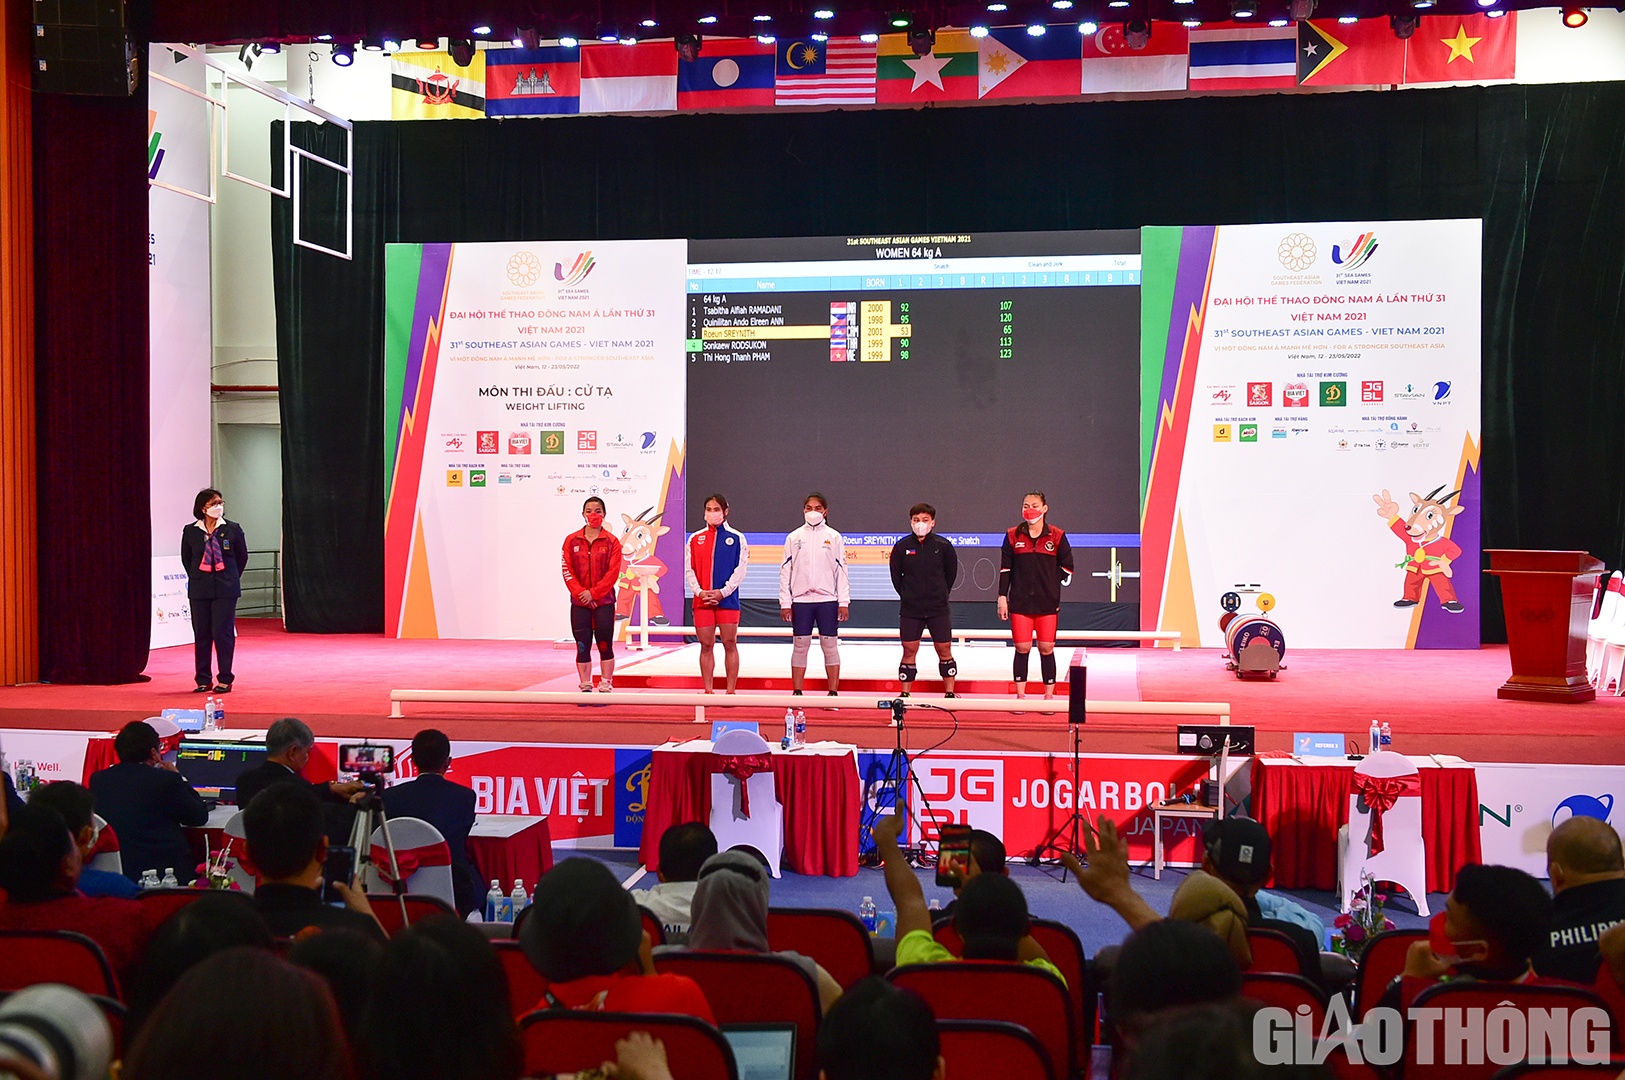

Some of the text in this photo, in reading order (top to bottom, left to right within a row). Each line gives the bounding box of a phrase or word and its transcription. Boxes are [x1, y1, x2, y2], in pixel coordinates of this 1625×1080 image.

[876, 247, 942, 260] WOMEN 64 kg A
[690, 278, 885, 290] No Name BORN
[703, 294, 727, 305] 64 kg A
[1214, 298, 1231, 306] ĐẠI
[1235, 296, 1253, 305] HỘI
[1313, 294, 1344, 303] ĐÔNG
[1376, 294, 1383, 302] Á
[1410, 293, 1433, 302] THỨ
[450, 311, 466, 320] ĐẠI
[468, 310, 485, 319] HỘI
[538, 309, 565, 318] ĐÔNG
[593, 308, 600, 316] Á
[624, 308, 644, 317] THỨ
[692, 307, 696, 315] 1
[749, 305, 782, 314] RAMADANI
[900, 303, 909, 312] 92
[1000, 301, 1013, 310] 107
[692, 319, 696, 327] 2
[733, 318, 749, 326] Ando
[770, 317, 784, 325] ANN
[868, 316, 883, 324] 1998
[900, 315, 909, 324] 95
[1000, 313, 1013, 322] 120
[1290, 312, 1313, 322] VIỆT
[517, 325, 538, 335] VIỆT
[692, 325, 1012, 339] 3 Roeun SREYNITH 2001 53 65
[703, 342, 730, 350] Sonkaew
[731, 341, 766, 349] RODSUKON
[900, 338, 909, 348] 90
[1000, 337, 1012, 346] 113
[692, 354, 696, 362] 5
[703, 353, 713, 362] Thi
[714, 353, 730, 363] Hong
[732, 352, 751, 361] Thanh
[752, 352, 771, 361] PHAM
[900, 350, 909, 359] 98
[1000, 349, 1012, 358] 123
[479, 385, 508, 396] MÔN
[512, 387, 532, 396] THI
[596, 387, 612, 398] TẠ
[844, 536, 862, 544] Roeun
[864, 536, 896, 544] SREYNITH
[958, 536, 980, 545] Snatch
[1261, 626, 1268, 636] 20
[1239, 632, 1250, 653] LEIKO
[37, 762, 61, 772] Well.
[920, 768, 994, 802] JG
[471, 771, 610, 824] BIA VIỆT
[1012, 778, 1201, 812] JOGARBO
[626, 814, 644, 824] ĐỘN
